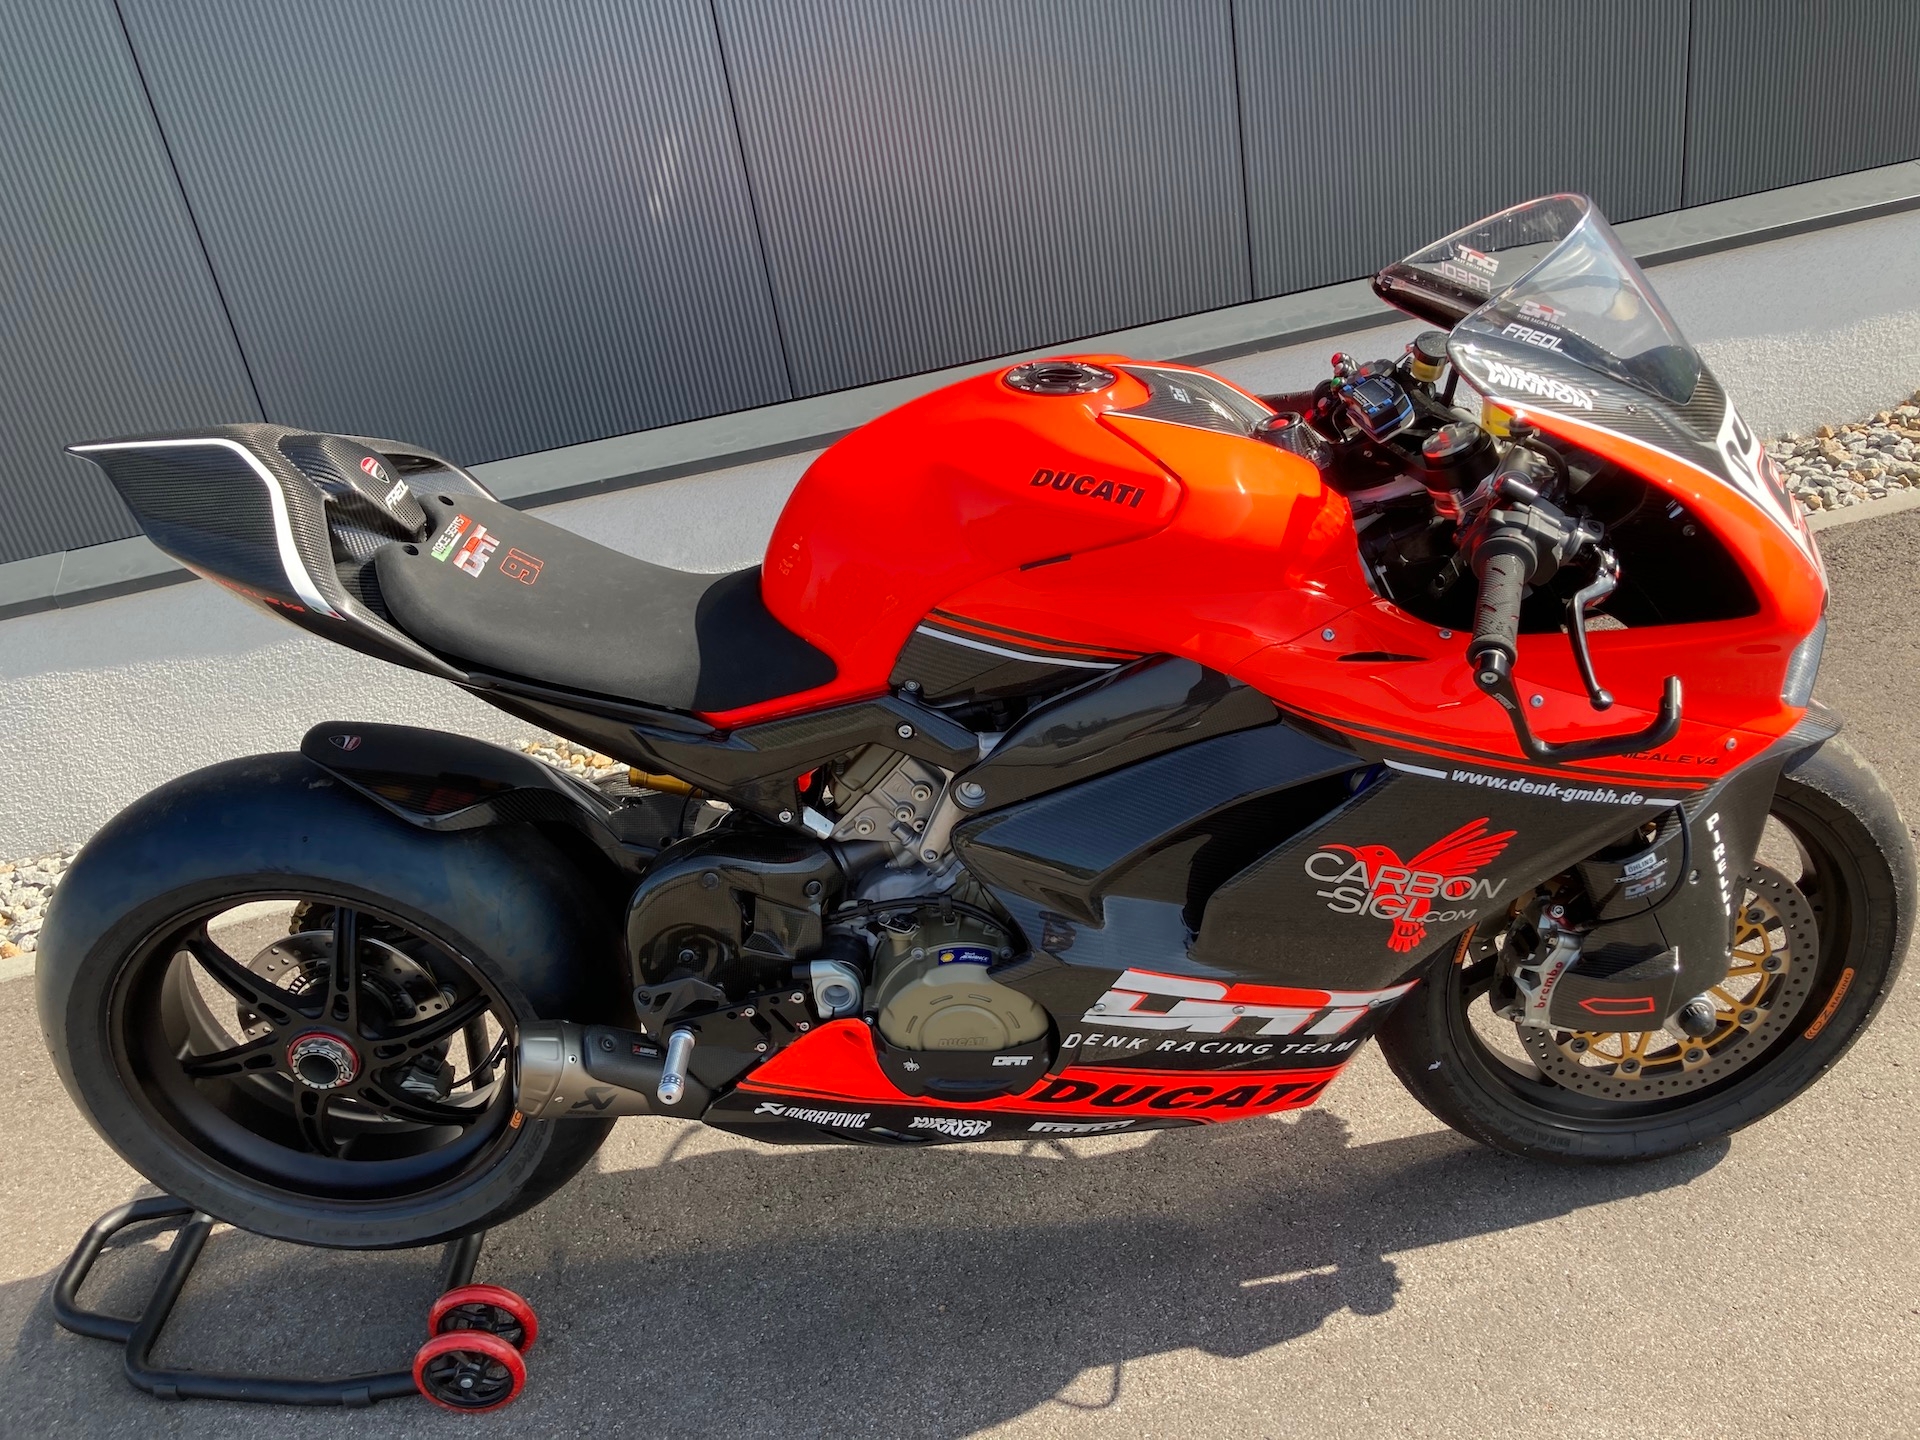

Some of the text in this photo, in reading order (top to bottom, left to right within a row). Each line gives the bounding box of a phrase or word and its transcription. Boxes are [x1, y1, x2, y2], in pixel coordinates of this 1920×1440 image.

[1531, 317, 1549, 328] RACING
[1548, 322, 1561, 331] TEAM
[1028, 467, 1147, 509] DUCATI
[1451, 769, 1644, 806] www.denk-gmbh.de
[1304, 852, 1508, 901] CARBON
[1706, 812, 1731, 917] PIRELLI
[1533, 961, 1564, 1009] brembo
[1830, 972, 1852, 1009] RACING
[937, 1036, 988, 1048] DUCATI
[1061, 1032, 1358, 1056] DENK RACING TEAM
[1029, 1078, 1333, 1110] DUCATI
[908, 1121, 991, 1138] WINNOW
[912, 1116, 992, 1130] MISSION
